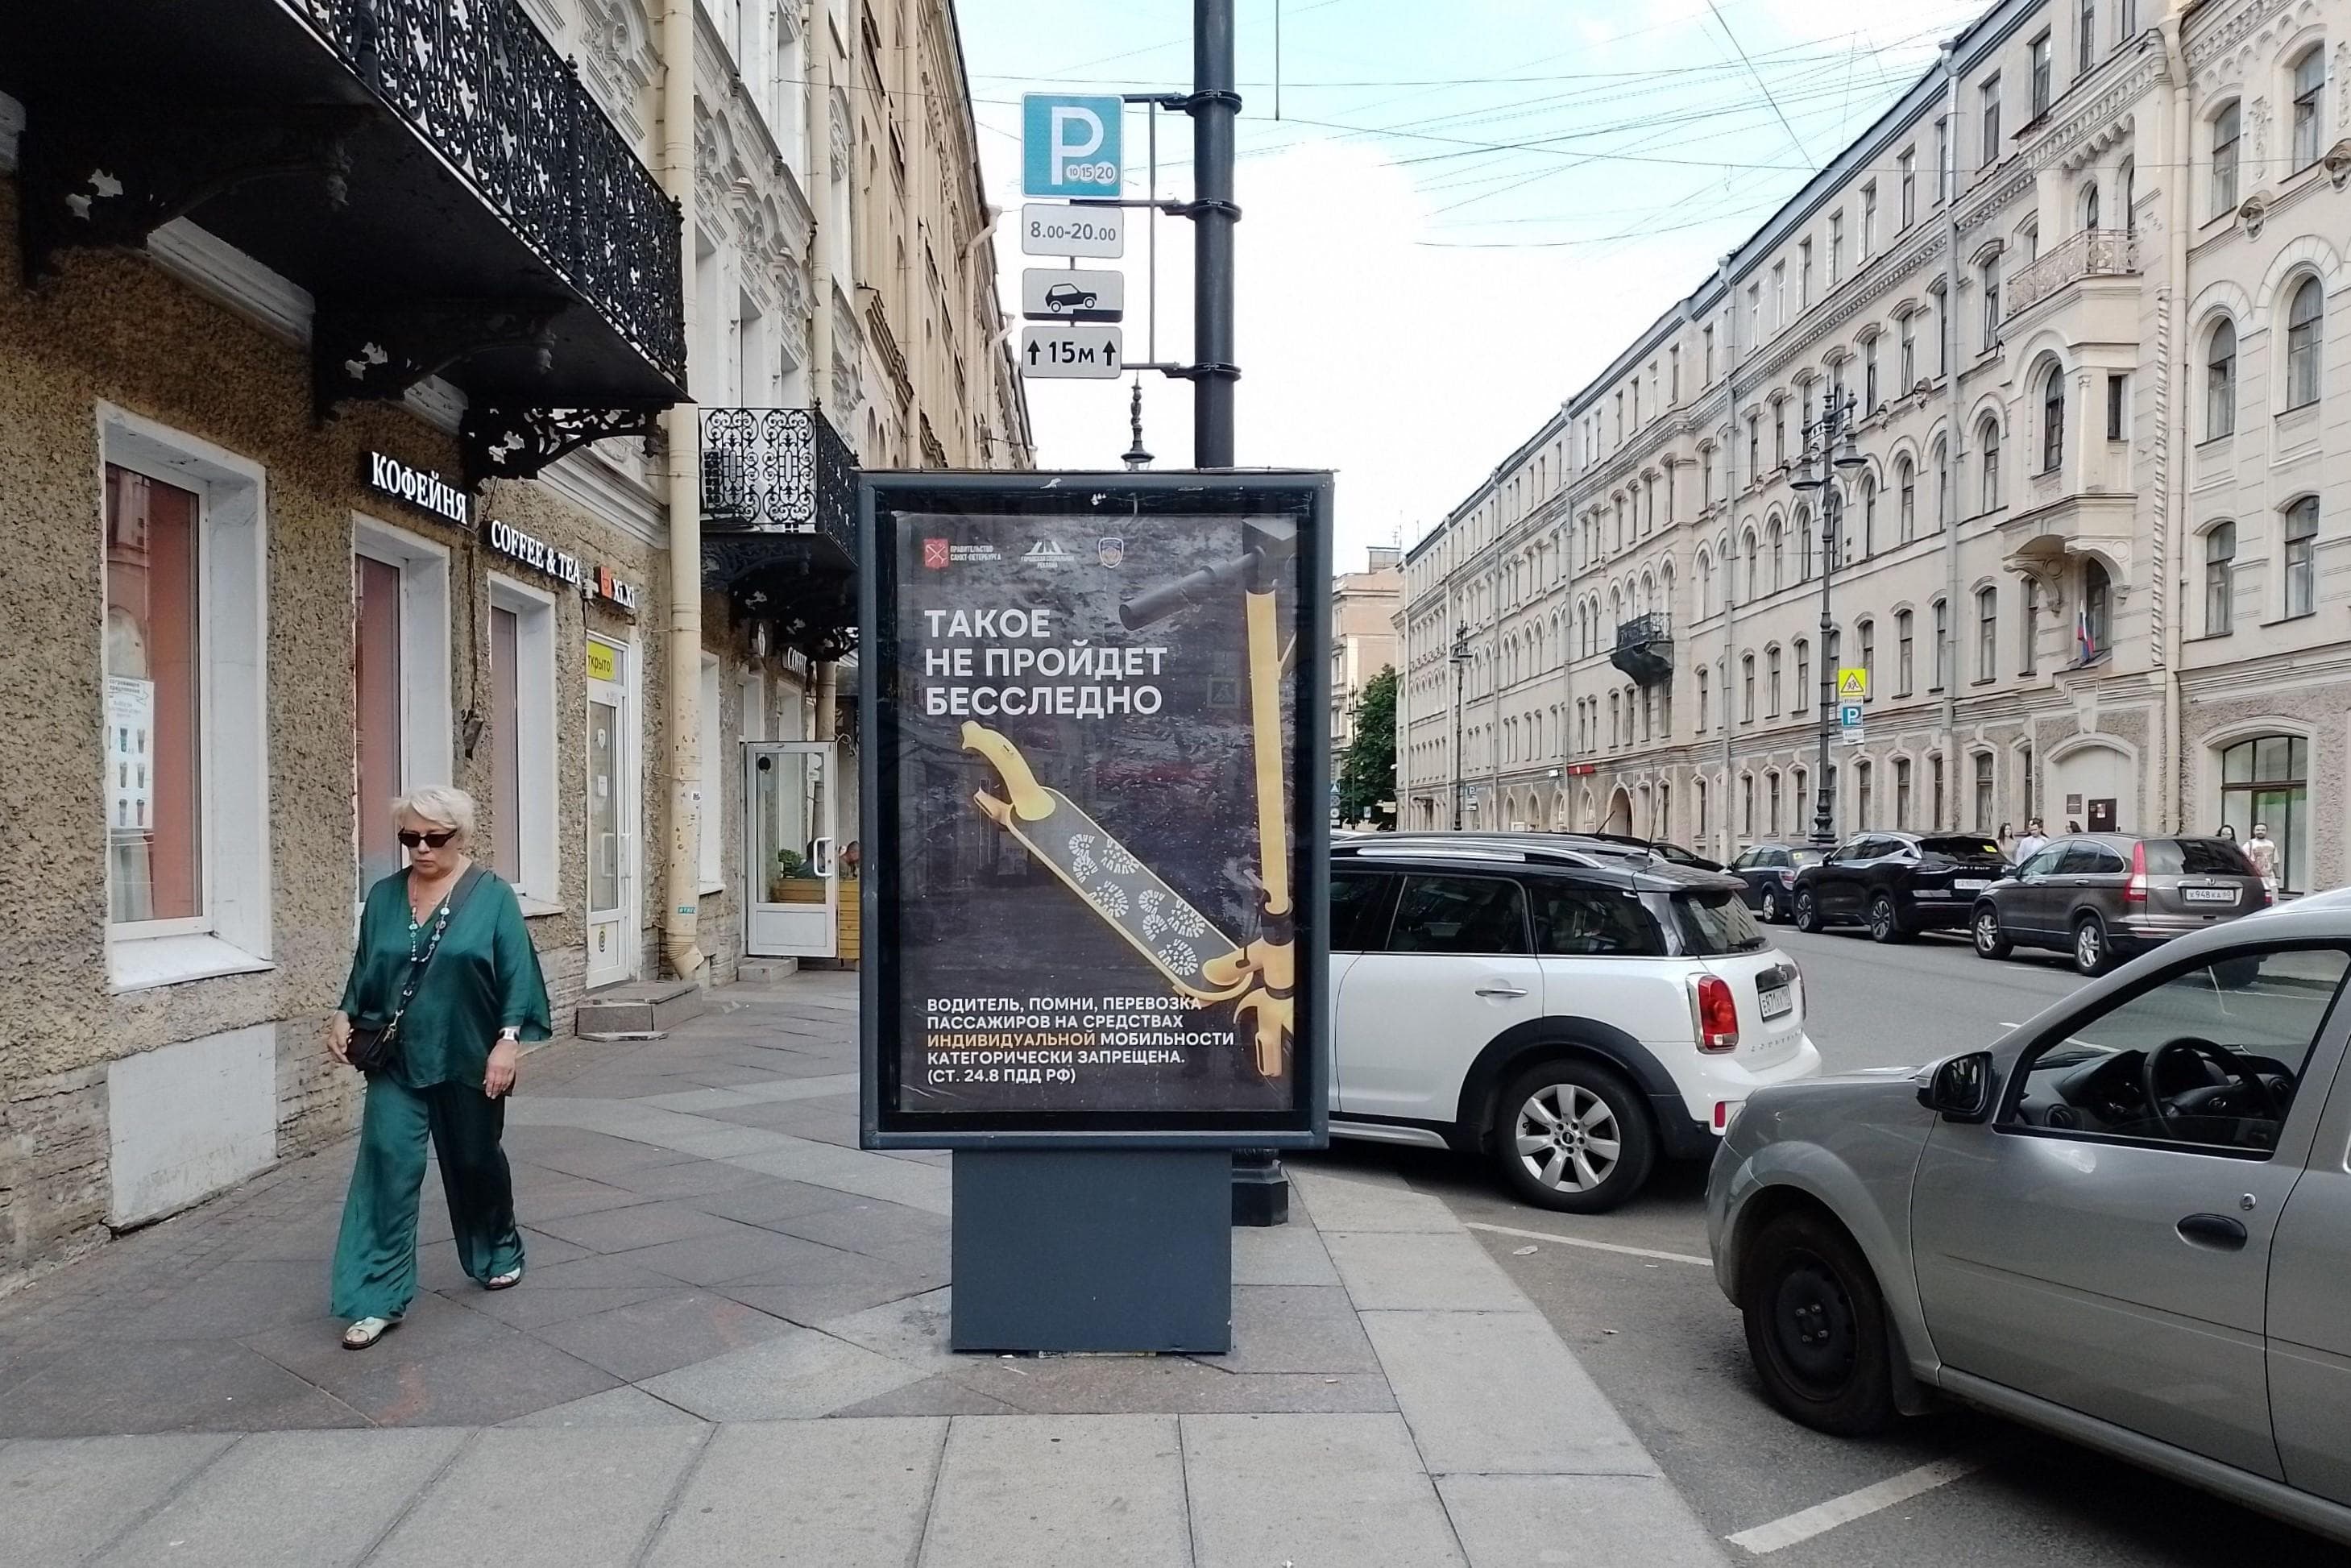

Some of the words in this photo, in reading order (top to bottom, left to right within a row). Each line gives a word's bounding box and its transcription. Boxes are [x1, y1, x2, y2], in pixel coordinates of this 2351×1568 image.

[1051, 106, 1105, 186] P
[1069, 168, 1078, 176] 10
[1082, 167, 1093, 177] 15
[1097, 166, 1113, 180] 20
[1030, 221, 1117, 242] 8.00-20.00
[371, 450, 467, 525] КОФЕЙНЯ
[491, 519, 544, 569] COFFEE
[546, 547, 556, 575] &
[558, 552, 581, 586] TEA
[924, 609, 1051, 638] ТАКОЕ
[587, 655, 612, 674] ткрыто!
[927, 648, 973, 676] НЕ
[985, 639, 1167, 681] ПРОЙДЕТ
[927, 685, 1163, 719] БЕССЛЕДНО
[1847, 708, 1859, 724] P
[927, 998, 1024, 1013] ВОДИТЕЛЬ,
[1029, 998, 1098, 1012] ПОМНИ,
[1103, 997, 1201, 1011] ПЕРЕВОЗКА
[927, 1015, 1051, 1030] ПАССАЖИРОВ
[1055, 1015, 1078, 1028] НА
[1082, 1014, 1184, 1030] СРЕДСТВАХ
[927, 1030, 1096, 1049] ИНДИВИДУАЛЬНОЙ
[1101, 1032, 1234, 1046] МОБИЛЬНОСТИ
[927, 1050, 1073, 1064] КАТЕГОРИЧЕСКИ
[1077, 1049, 1185, 1065] ЗАПРЕЩЕНА.
[927, 1069, 960, 1085] (СТ.
[964, 1069, 999, 1083] 24.8
[1004, 1068, 1042, 1085] ПДД
[1046, 1068, 1076, 1085] РФ)
